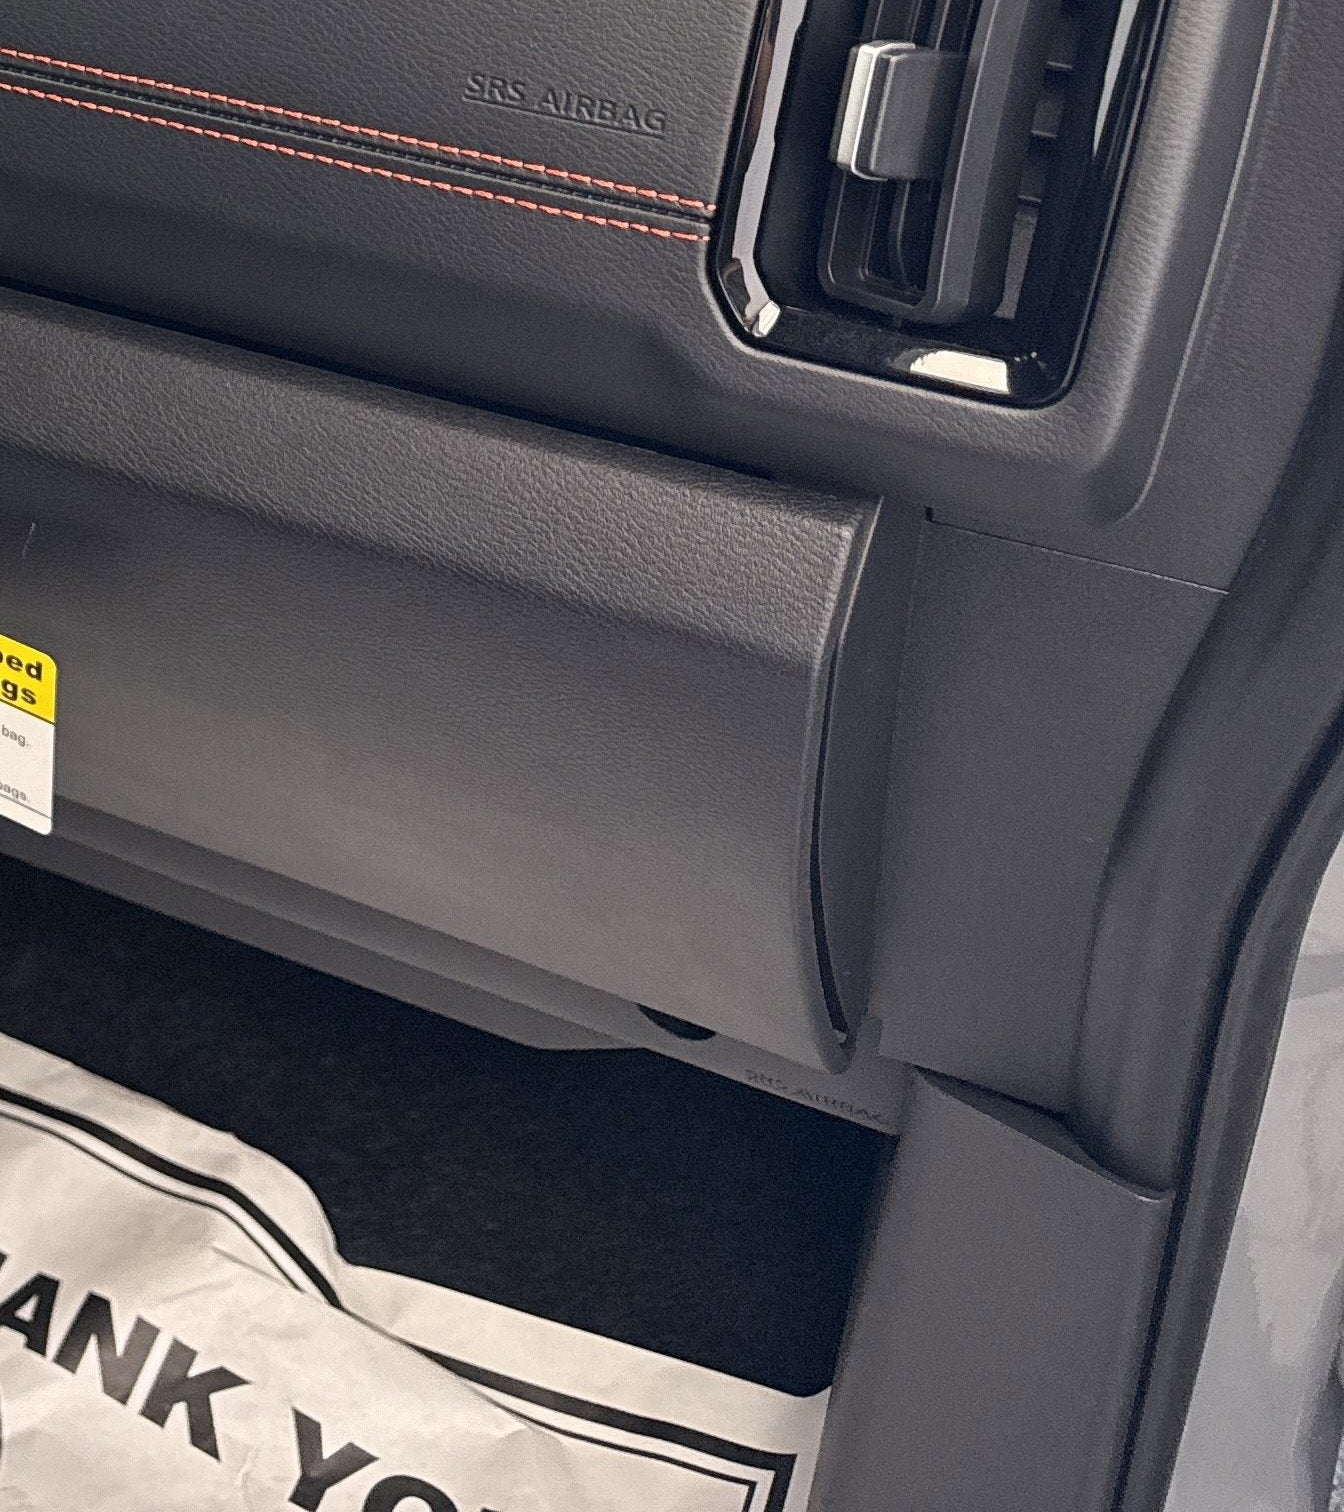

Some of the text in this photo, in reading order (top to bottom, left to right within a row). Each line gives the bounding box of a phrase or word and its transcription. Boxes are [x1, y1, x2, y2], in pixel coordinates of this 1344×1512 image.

[463, 71, 667, 134] SRS AIRBAG
[2, 724, 30, 748] bag.
